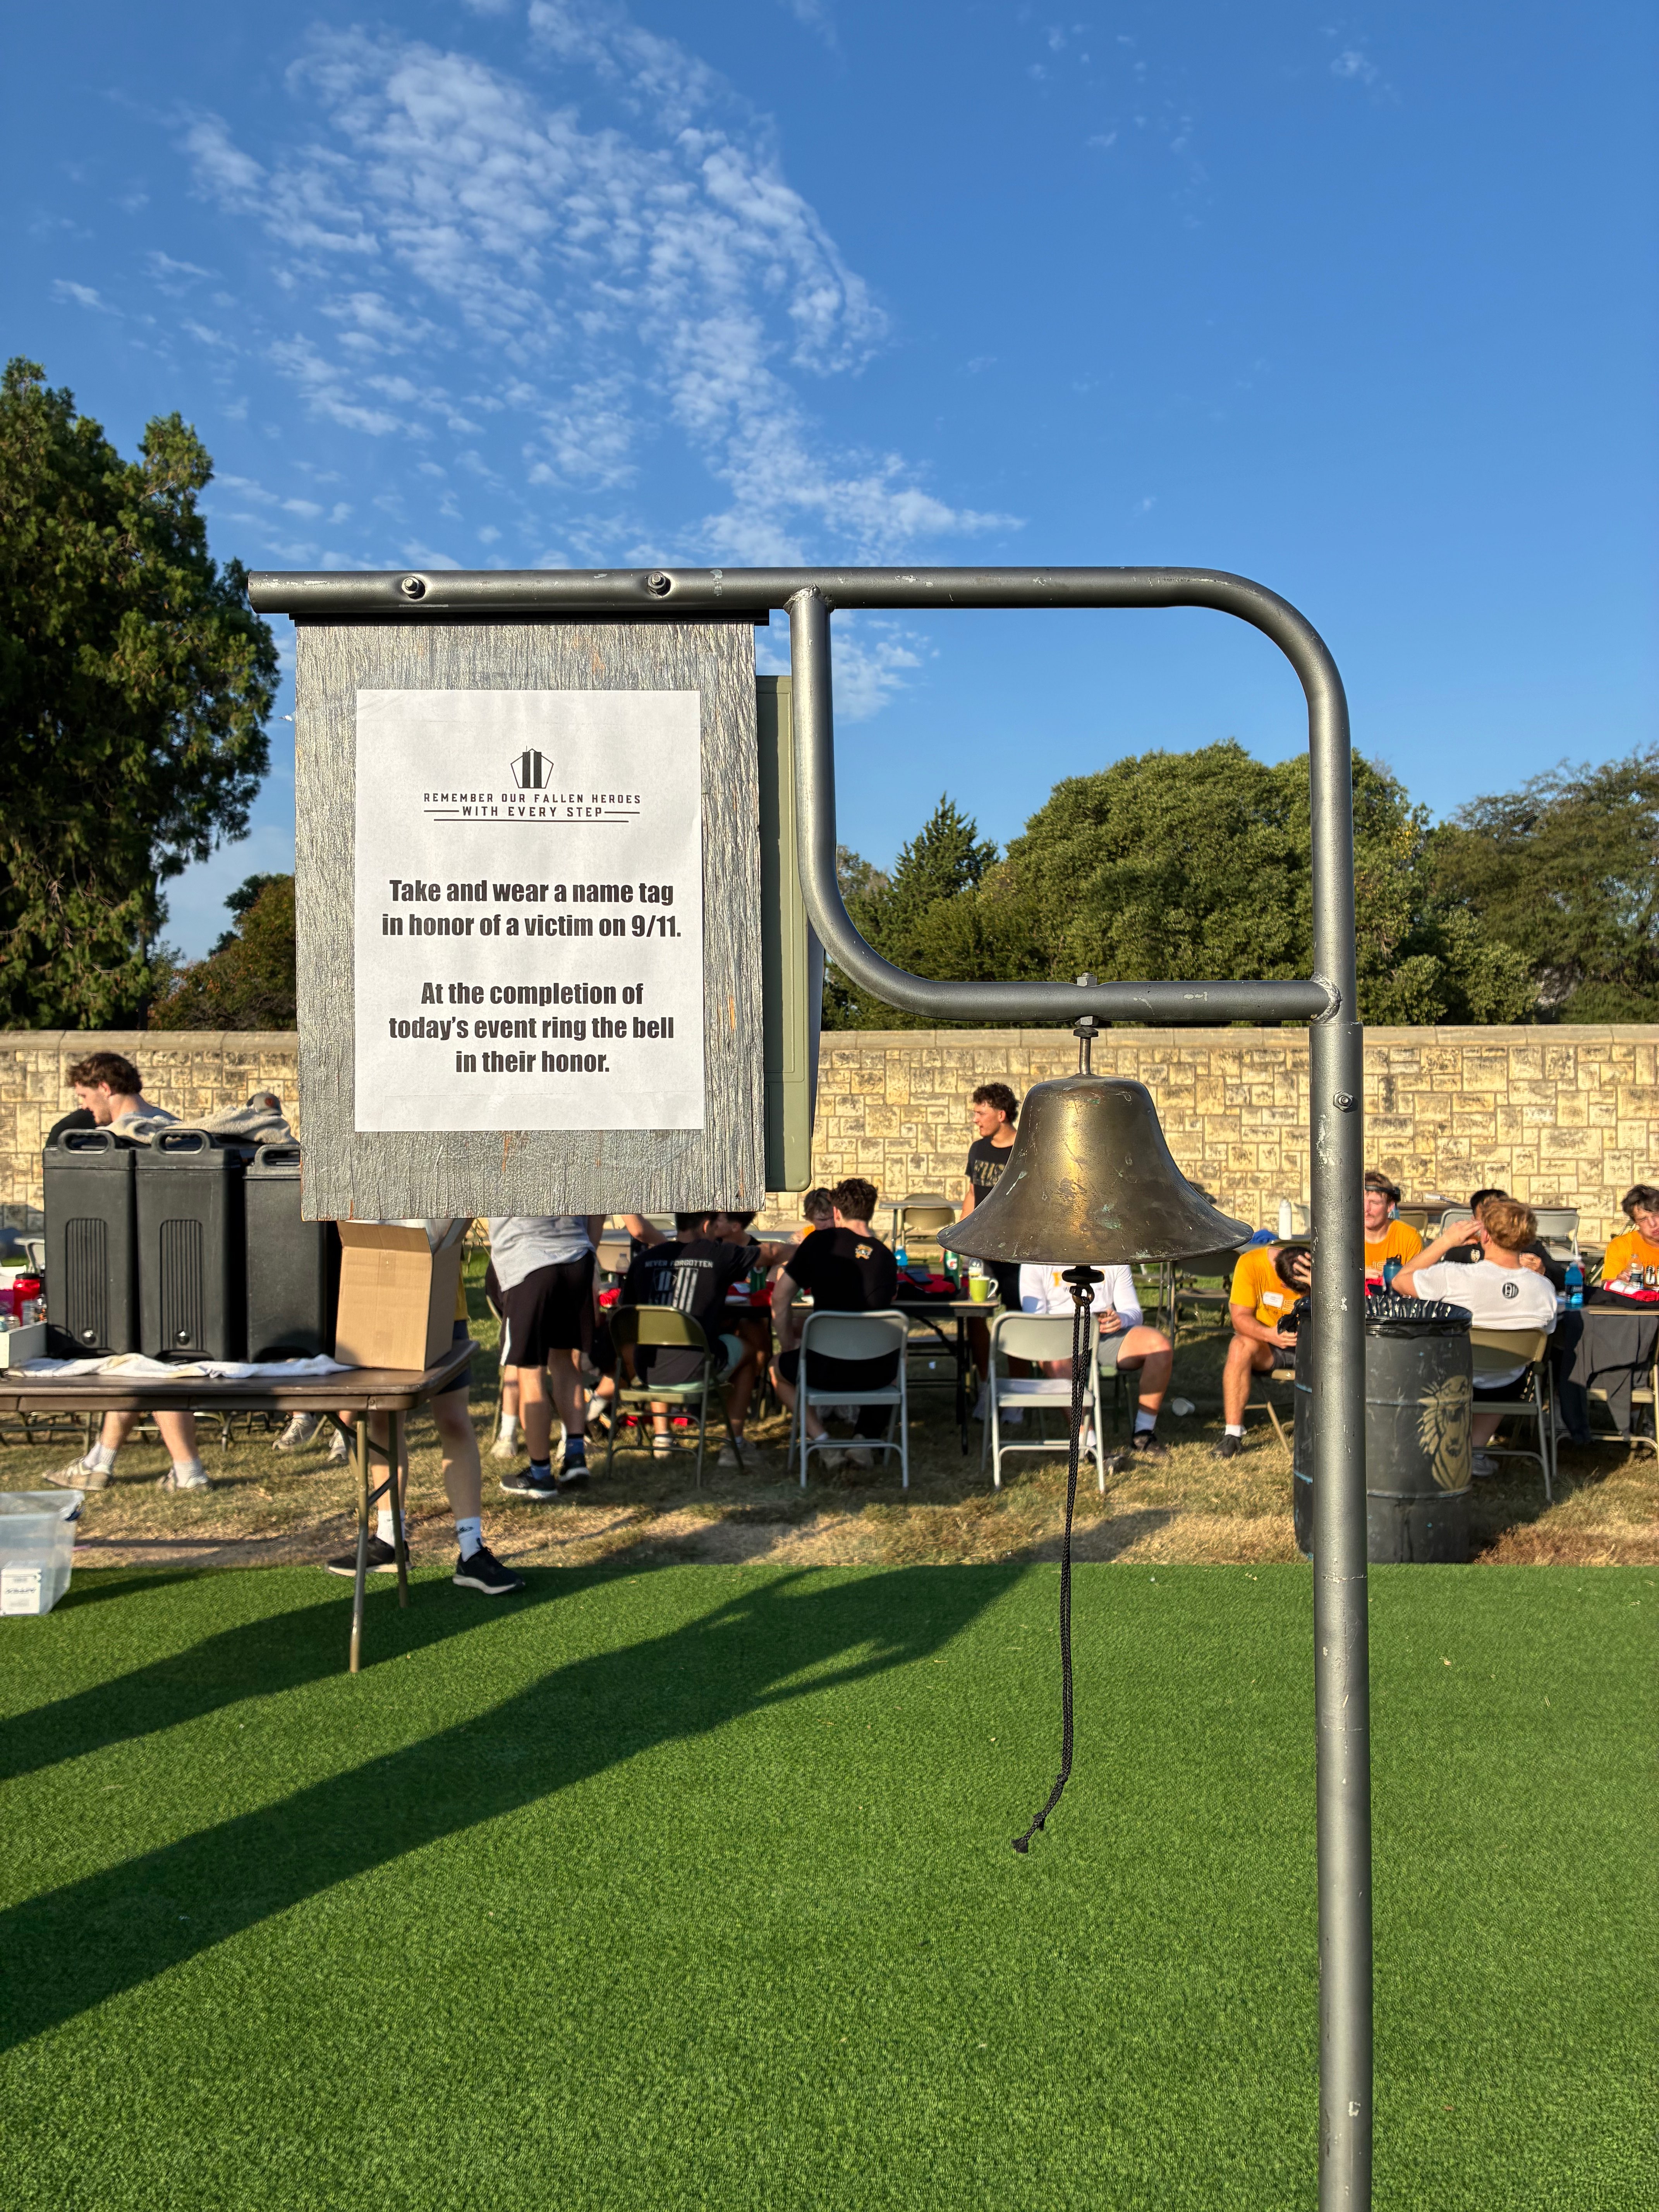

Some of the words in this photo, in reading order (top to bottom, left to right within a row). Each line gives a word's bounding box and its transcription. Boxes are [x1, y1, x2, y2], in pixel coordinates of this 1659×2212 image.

[424, 793, 493, 803] REMEMBER
[501, 793, 525, 803] OUR
[534, 794, 583, 803] FALLEN
[592, 794, 640, 804] HEROES
[462, 806, 498, 816] WITH
[508, 806, 556, 817] EVERY
[567, 807, 601, 817] STEP
[389, 880, 441, 902] Take
[447, 880, 487, 902] and
[493, 884, 549, 902] wear
[554, 884, 567, 902] a
[573, 884, 633, 903] name
[639, 883, 673, 906] tag
[383, 914, 403, 935] in
[409, 914, 474, 936] honor
[480, 914, 501, 936] of
[506, 918, 519, 936] a
[524, 914, 593, 936] victim
[599, 918, 625, 936] on
[632, 915, 681, 937] 9/11.
[421, 982, 443, 1004] At
[448, 982, 484, 1004] the
[490, 982, 616, 1006] completion
[622, 983, 644, 1004] of
[389, 1017, 469, 1041] today's
[474, 1018, 537, 1038] event
[543, 1017, 586, 1041] ring
[592, 1017, 627, 1038] the
[633, 1017, 673, 1039] bell
[456, 1051, 476, 1072] in
[482, 1051, 536, 1072] their
[542, 1051, 609, 1072] honor.
[670, 1259, 714, 1268] FORGOTTEN
